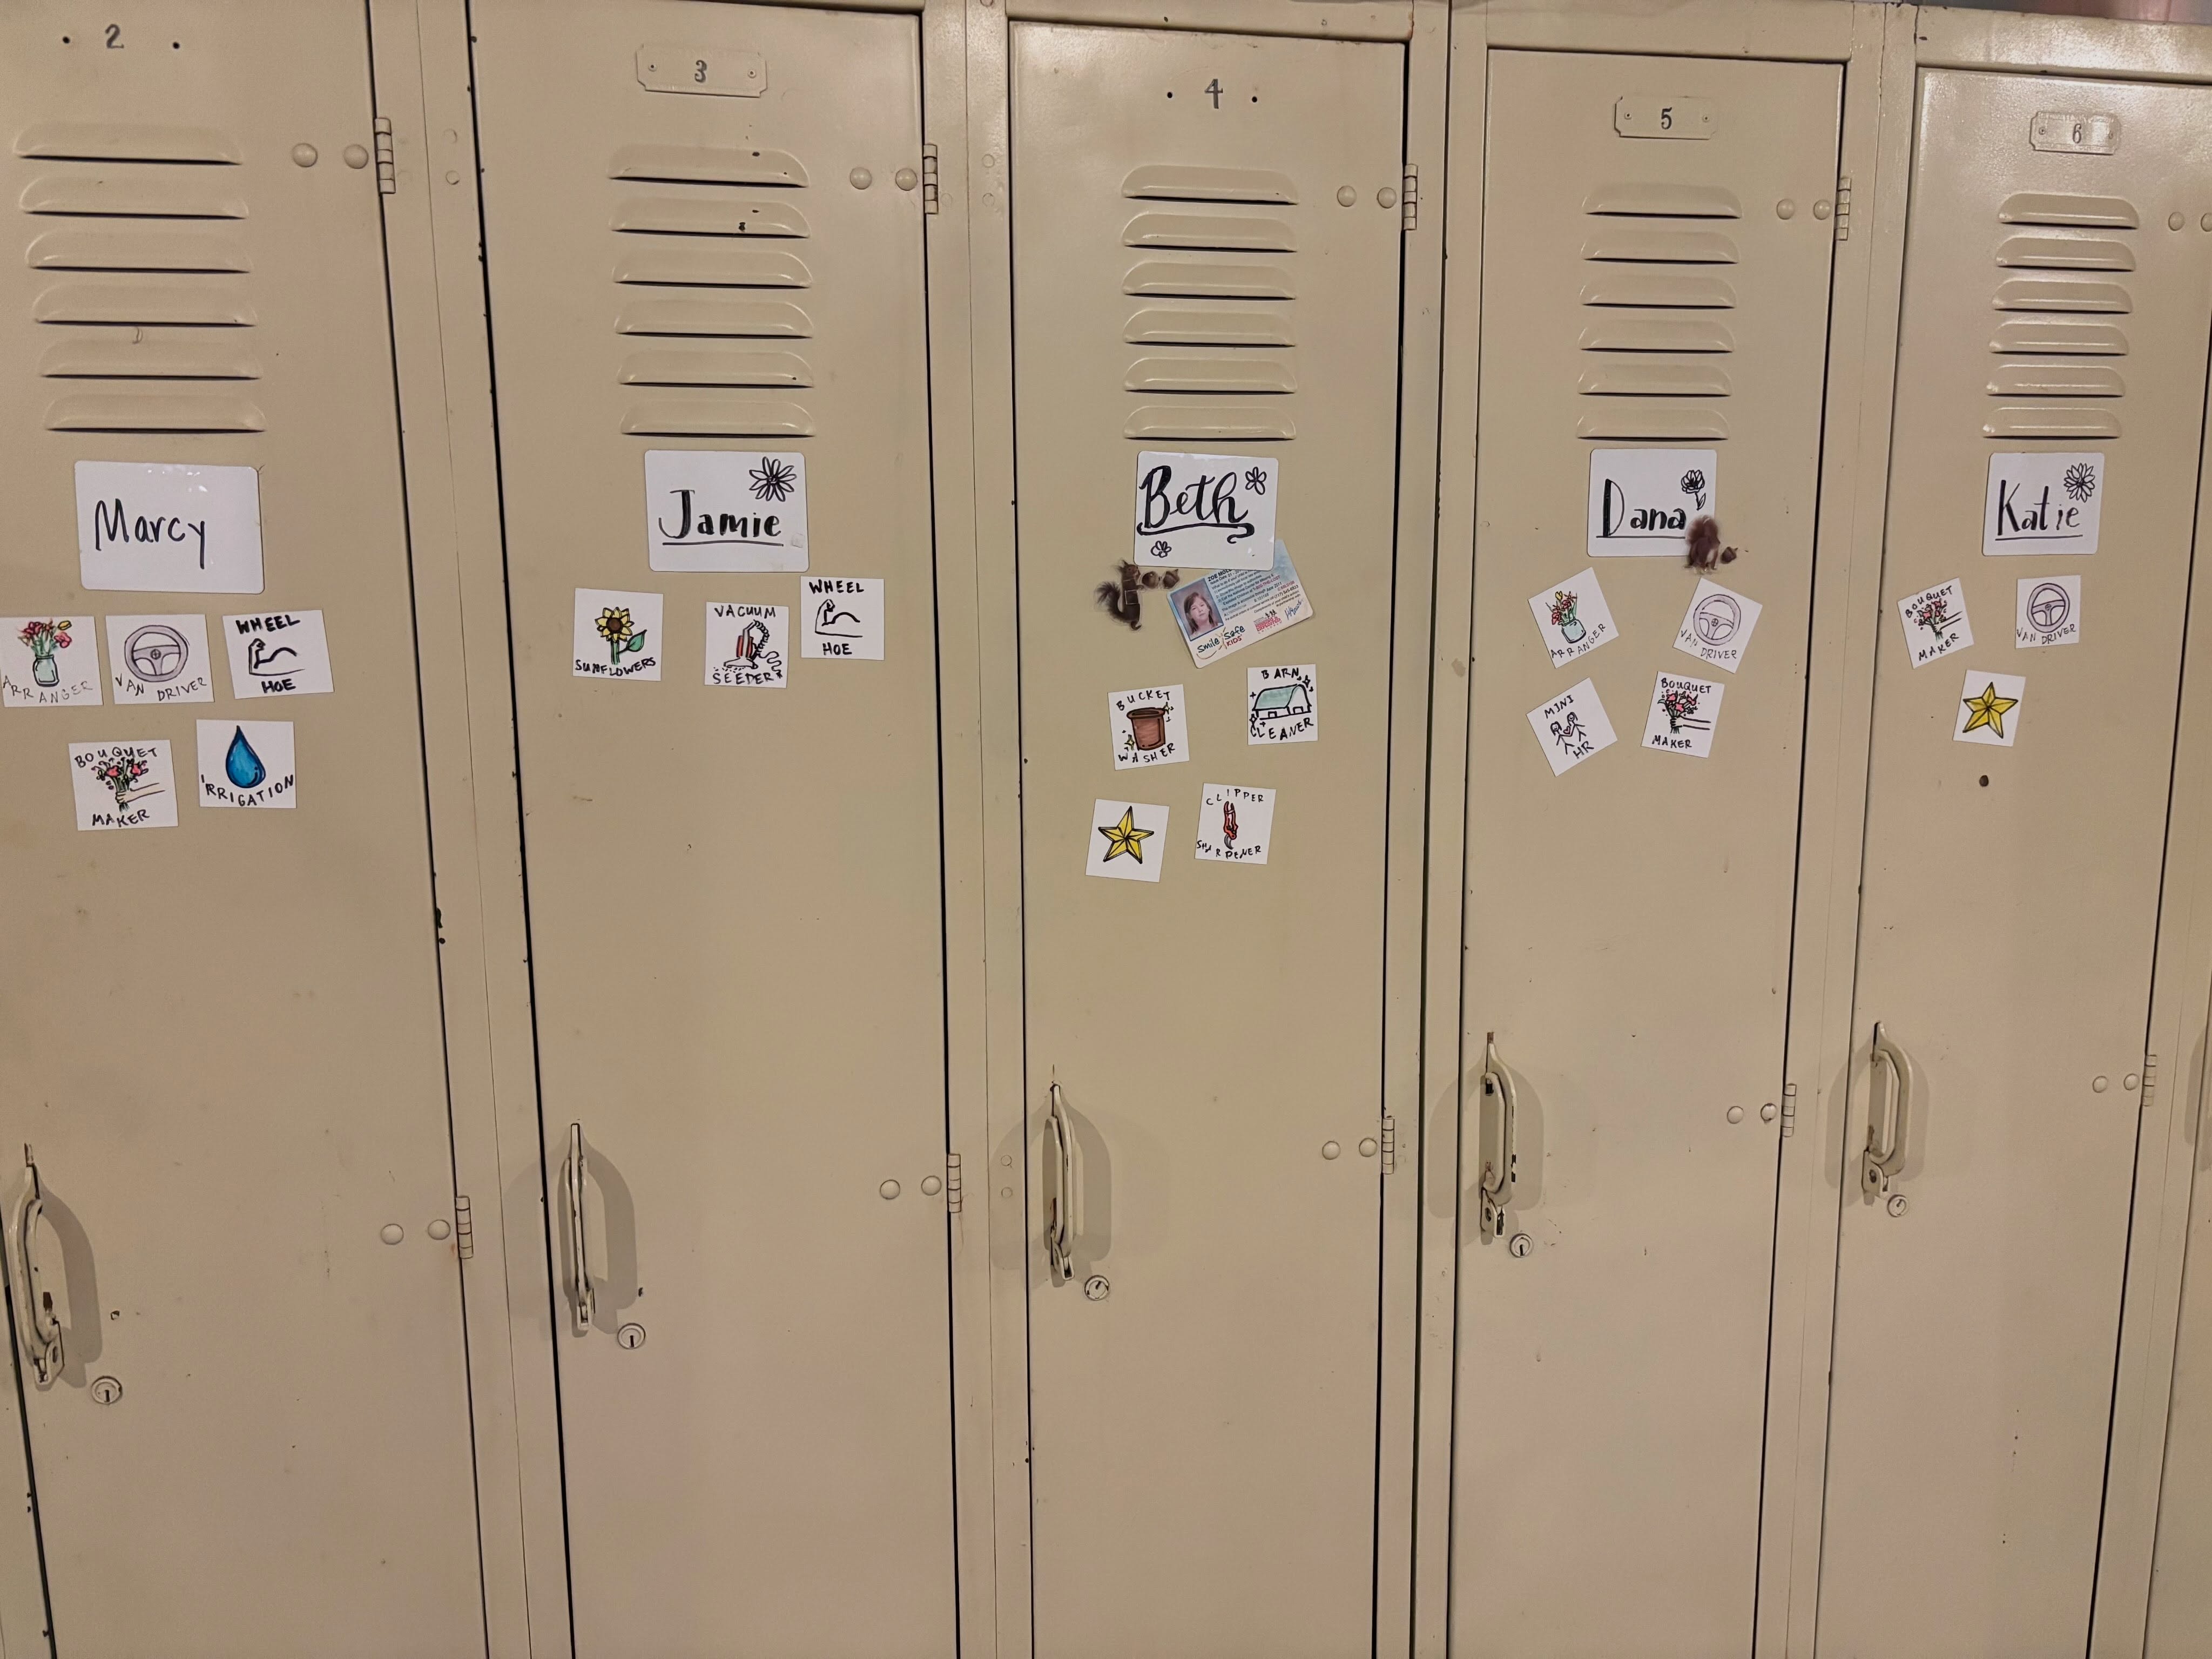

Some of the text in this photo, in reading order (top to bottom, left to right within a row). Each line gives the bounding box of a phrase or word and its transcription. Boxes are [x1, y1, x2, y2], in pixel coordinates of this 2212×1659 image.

[105, 24, 124, 49] 2
[694, 60, 707, 83] 3
[1204, 78, 1223, 109] 4
[1661, 107, 1673, 130] 5
[2072, 123, 2082, 144] 6
[1138, 465, 1248, 529] Beth
[1603, 479, 1687, 537] Dana
[1998, 480, 2081, 536] Katie
[658, 489, 783, 539] Jamie
[95, 498, 205, 569] Marcy
[810, 579, 865, 594] WHEEL
[714, 605, 777, 618] VACUUM
[1905, 585, 1953, 618] BOUQUET
[236, 615, 301, 635] WHEEL
[2017, 624, 2076, 644] VAN DRIVER
[822, 643, 852, 656] HOE
[1197, 625, 1245, 653] smile safe
[1550, 624, 1606, 658] ARRANGER
[1681, 629, 1737, 659] VAN DRIVER
[1918, 632, 1959, 661] MAKER
[575, 656, 656, 676] SUNFLOWERS
[1262, 667, 1299, 679] BARN
[2, 676, 93, 703] ARRANGER
[115, 674, 207, 702] VAN DRIVER
[261, 679, 296, 694] HOE
[712, 672, 775, 685] SEEDER
[1661, 678, 1712, 694] BOUQUET
[1117, 690, 1171, 711] BUCKET
[1544, 694, 1574, 719] MINI
[1250, 718, 1313, 740] CLEANER
[1118, 742, 1176, 763] WASHER
[1573, 741, 1595, 759] HR
[1652, 735, 1692, 749] MAKER
[75, 746, 158, 768] BOUQUET
[200, 774, 294, 807] IRRIGATION
[1206, 788, 1264, 803] CLIPPER
[92, 808, 150, 828] MAKER
[1196, 840, 1262, 859] SHARPENER
